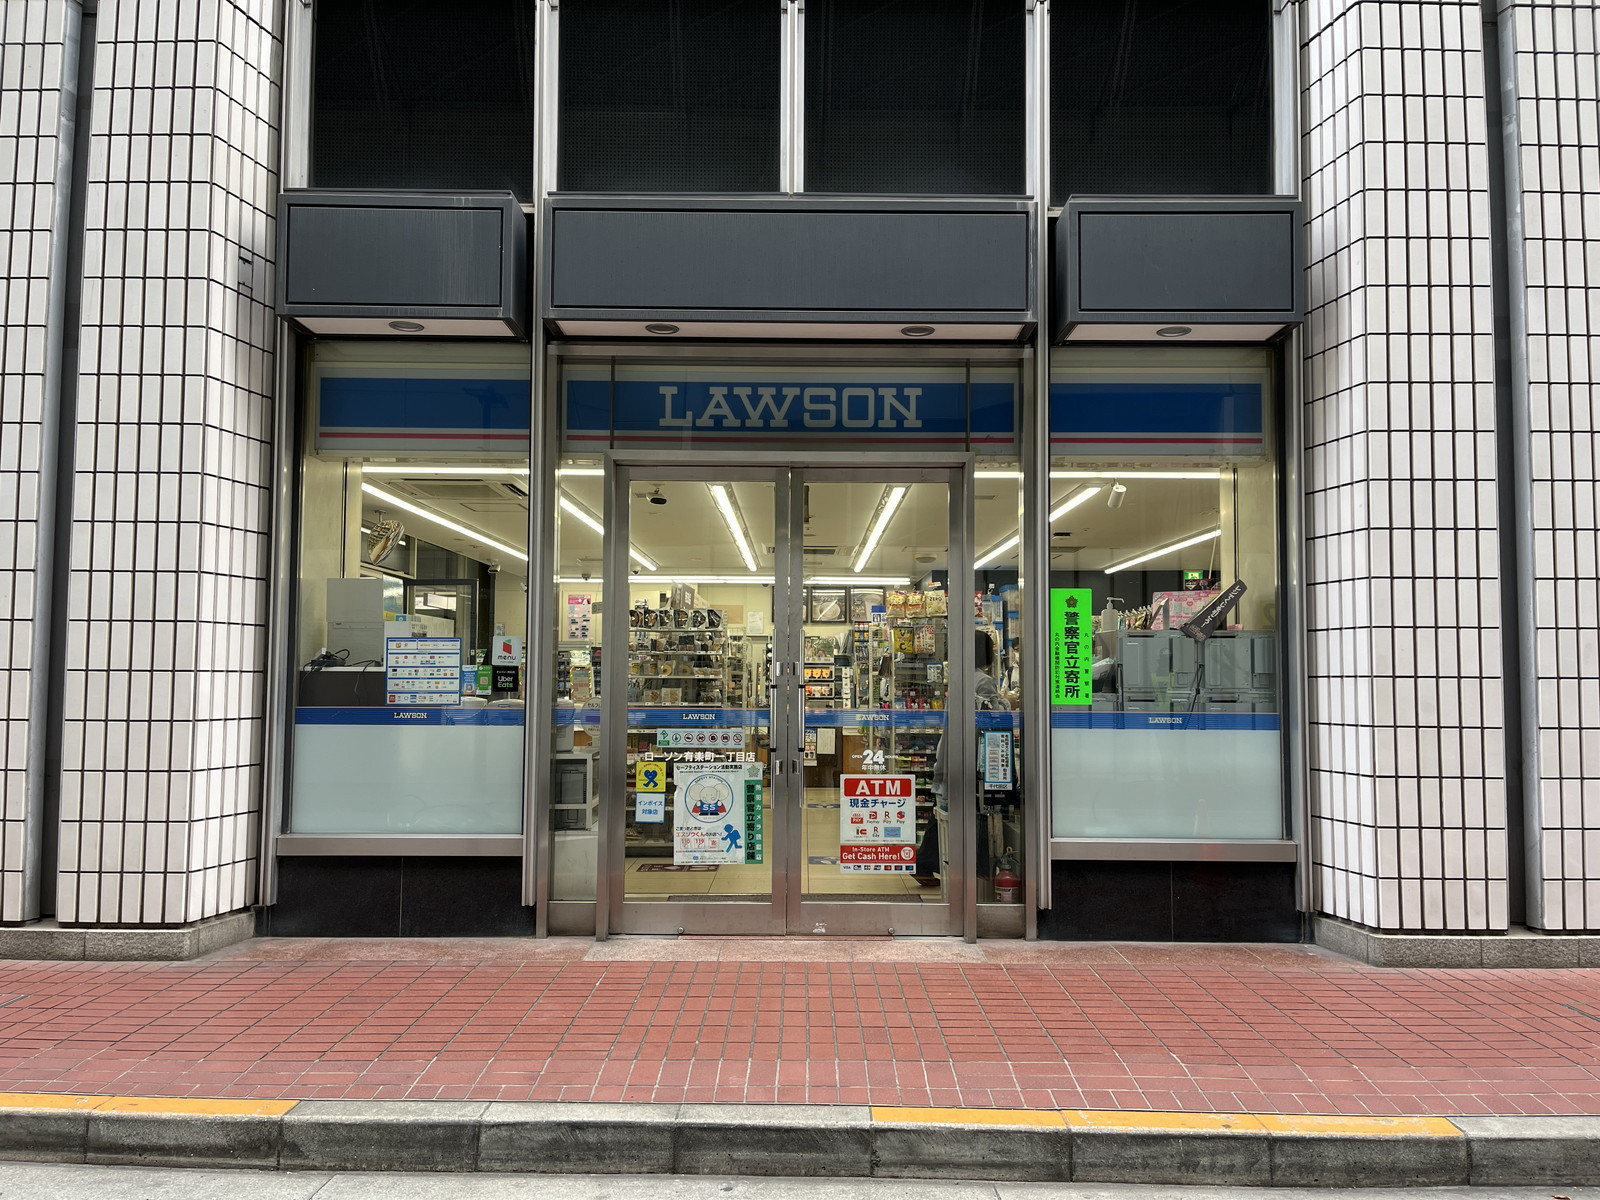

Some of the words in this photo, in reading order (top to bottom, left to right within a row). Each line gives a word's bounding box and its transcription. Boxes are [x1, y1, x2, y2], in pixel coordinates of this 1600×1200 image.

[659, 386, 922, 428] LAWSON
[1064, 611, 1081, 698] 警察官立寄所
[644, 751, 756, 762] ローソン有楽町一丁目店
[862, 749, 885, 765] 24
[855, 780, 901, 795] ATM
[849, 798, 906, 808] 現金チャージ
[884, 811, 890, 819] R
[842, 852, 855, 860] Get
[857, 852, 876, 860] Cash
[878, 852, 900, 860] Here!
